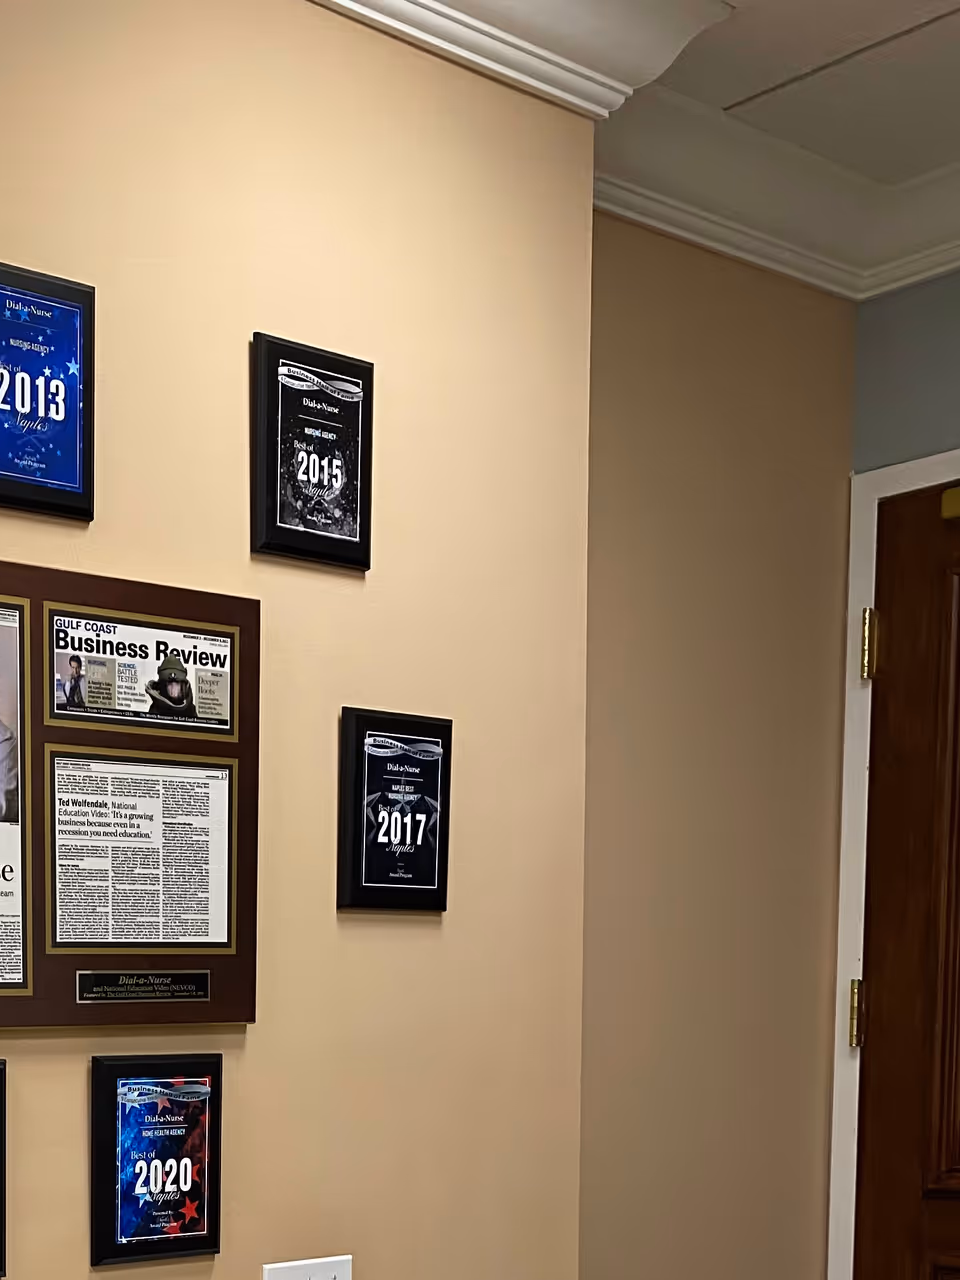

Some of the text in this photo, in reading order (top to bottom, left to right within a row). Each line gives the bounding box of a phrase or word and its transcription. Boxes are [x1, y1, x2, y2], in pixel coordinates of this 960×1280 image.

[6, 299, 52, 318] Dial-a-Nurse
[288, 368, 315, 383] Business
[303, 398, 339, 413] Dial-a-Nurse
[297, 451, 342, 488] 2015
[55, 619, 117, 634] GULF COAST
[55, 628, 227, 668] Business Review
[118, 668, 137, 676] BATTLE
[373, 738, 398, 748] Business
[58, 798, 137, 809] Ted Wolfendale, National
[58, 808, 89, 817] Education
[91, 810, 110, 818] Video:
[128, 813, 154, 822] growing
[58, 818, 86, 827] business
[87, 820, 112, 828] because
[129, 821, 135, 829] in
[377, 811, 427, 845] 2017
[102, 829, 118, 837] need
[386, 840, 415, 857] Naples
[118, 975, 171, 985] Dial-a-Nurse
[127, 1086, 158, 1094] Business
[145, 1115, 184, 1123] Dial-a-Nurse
[131, 1150, 156, 1159] Best of
[134, 1157, 192, 1194] 2020
